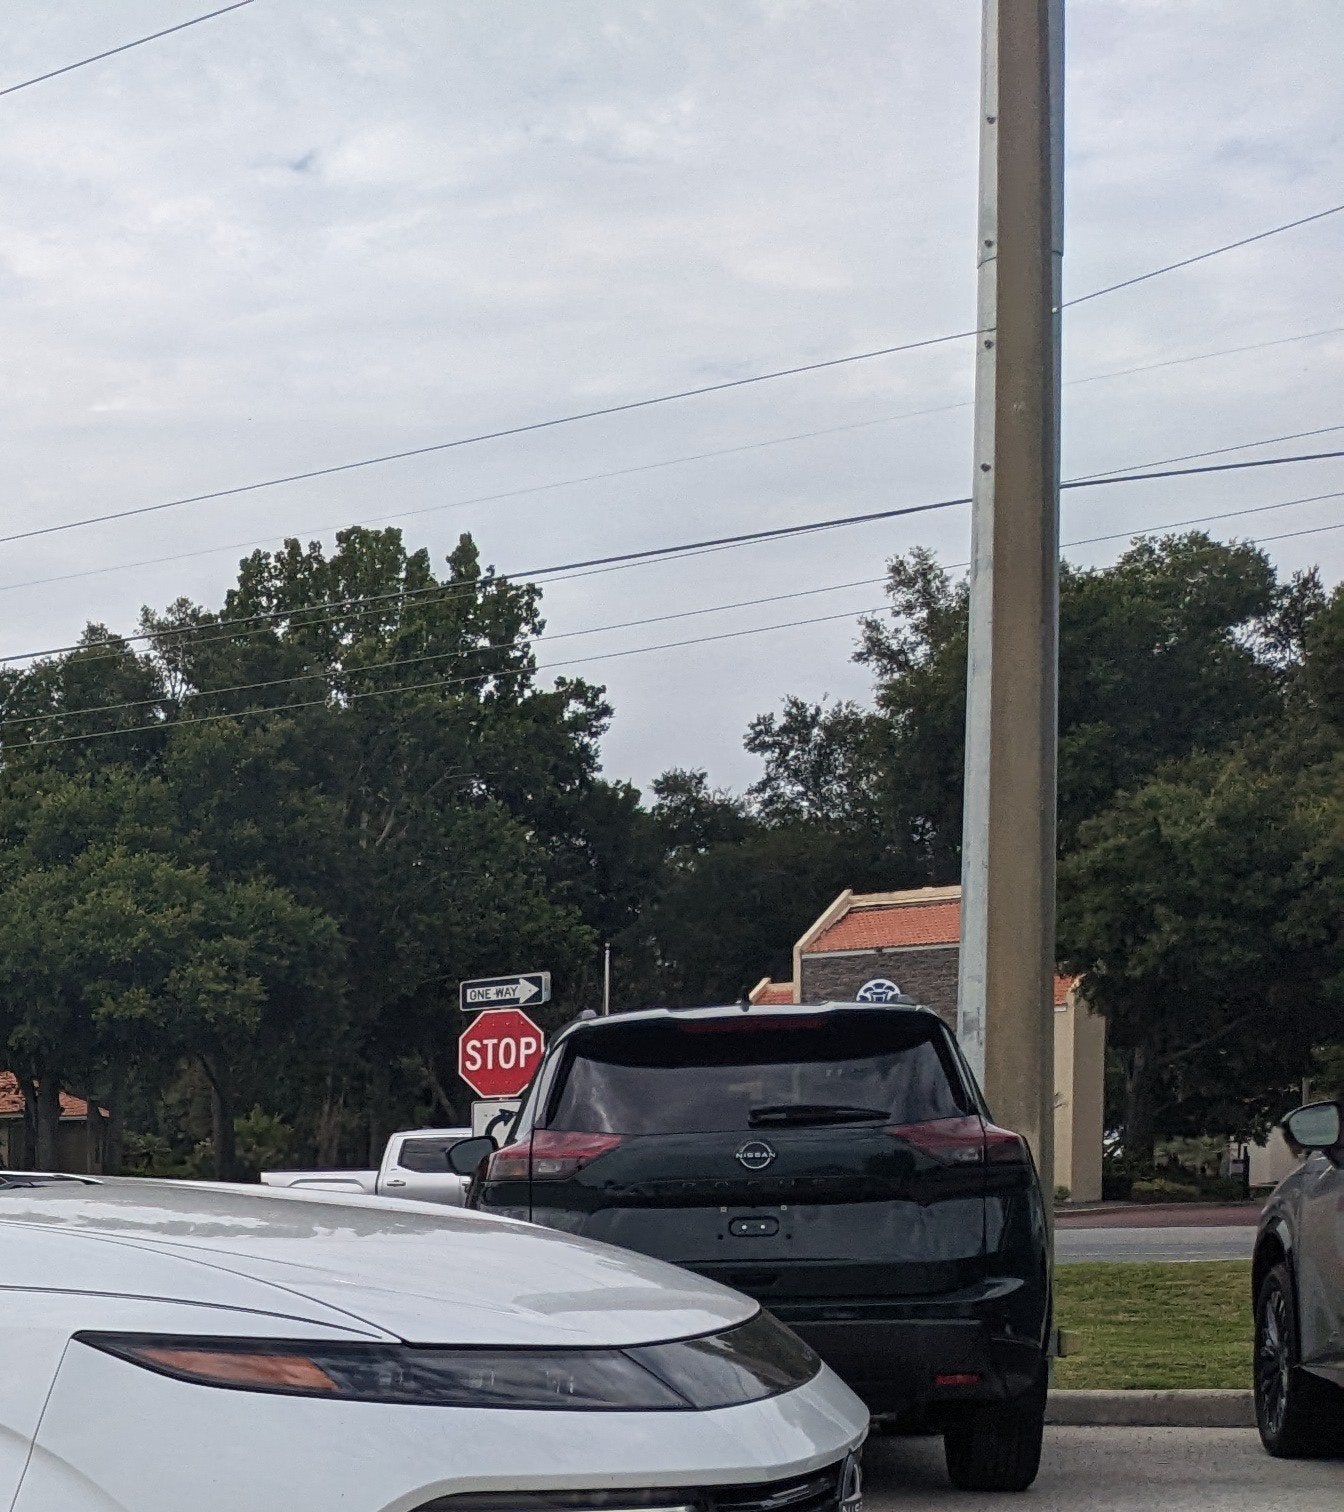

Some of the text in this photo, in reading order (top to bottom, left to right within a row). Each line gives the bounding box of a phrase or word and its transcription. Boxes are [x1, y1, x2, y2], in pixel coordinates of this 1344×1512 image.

[469, 985, 519, 1001] ONE WAY
[464, 1036, 537, 1071] STOP
[735, 1151, 776, 1159] NISSAN
